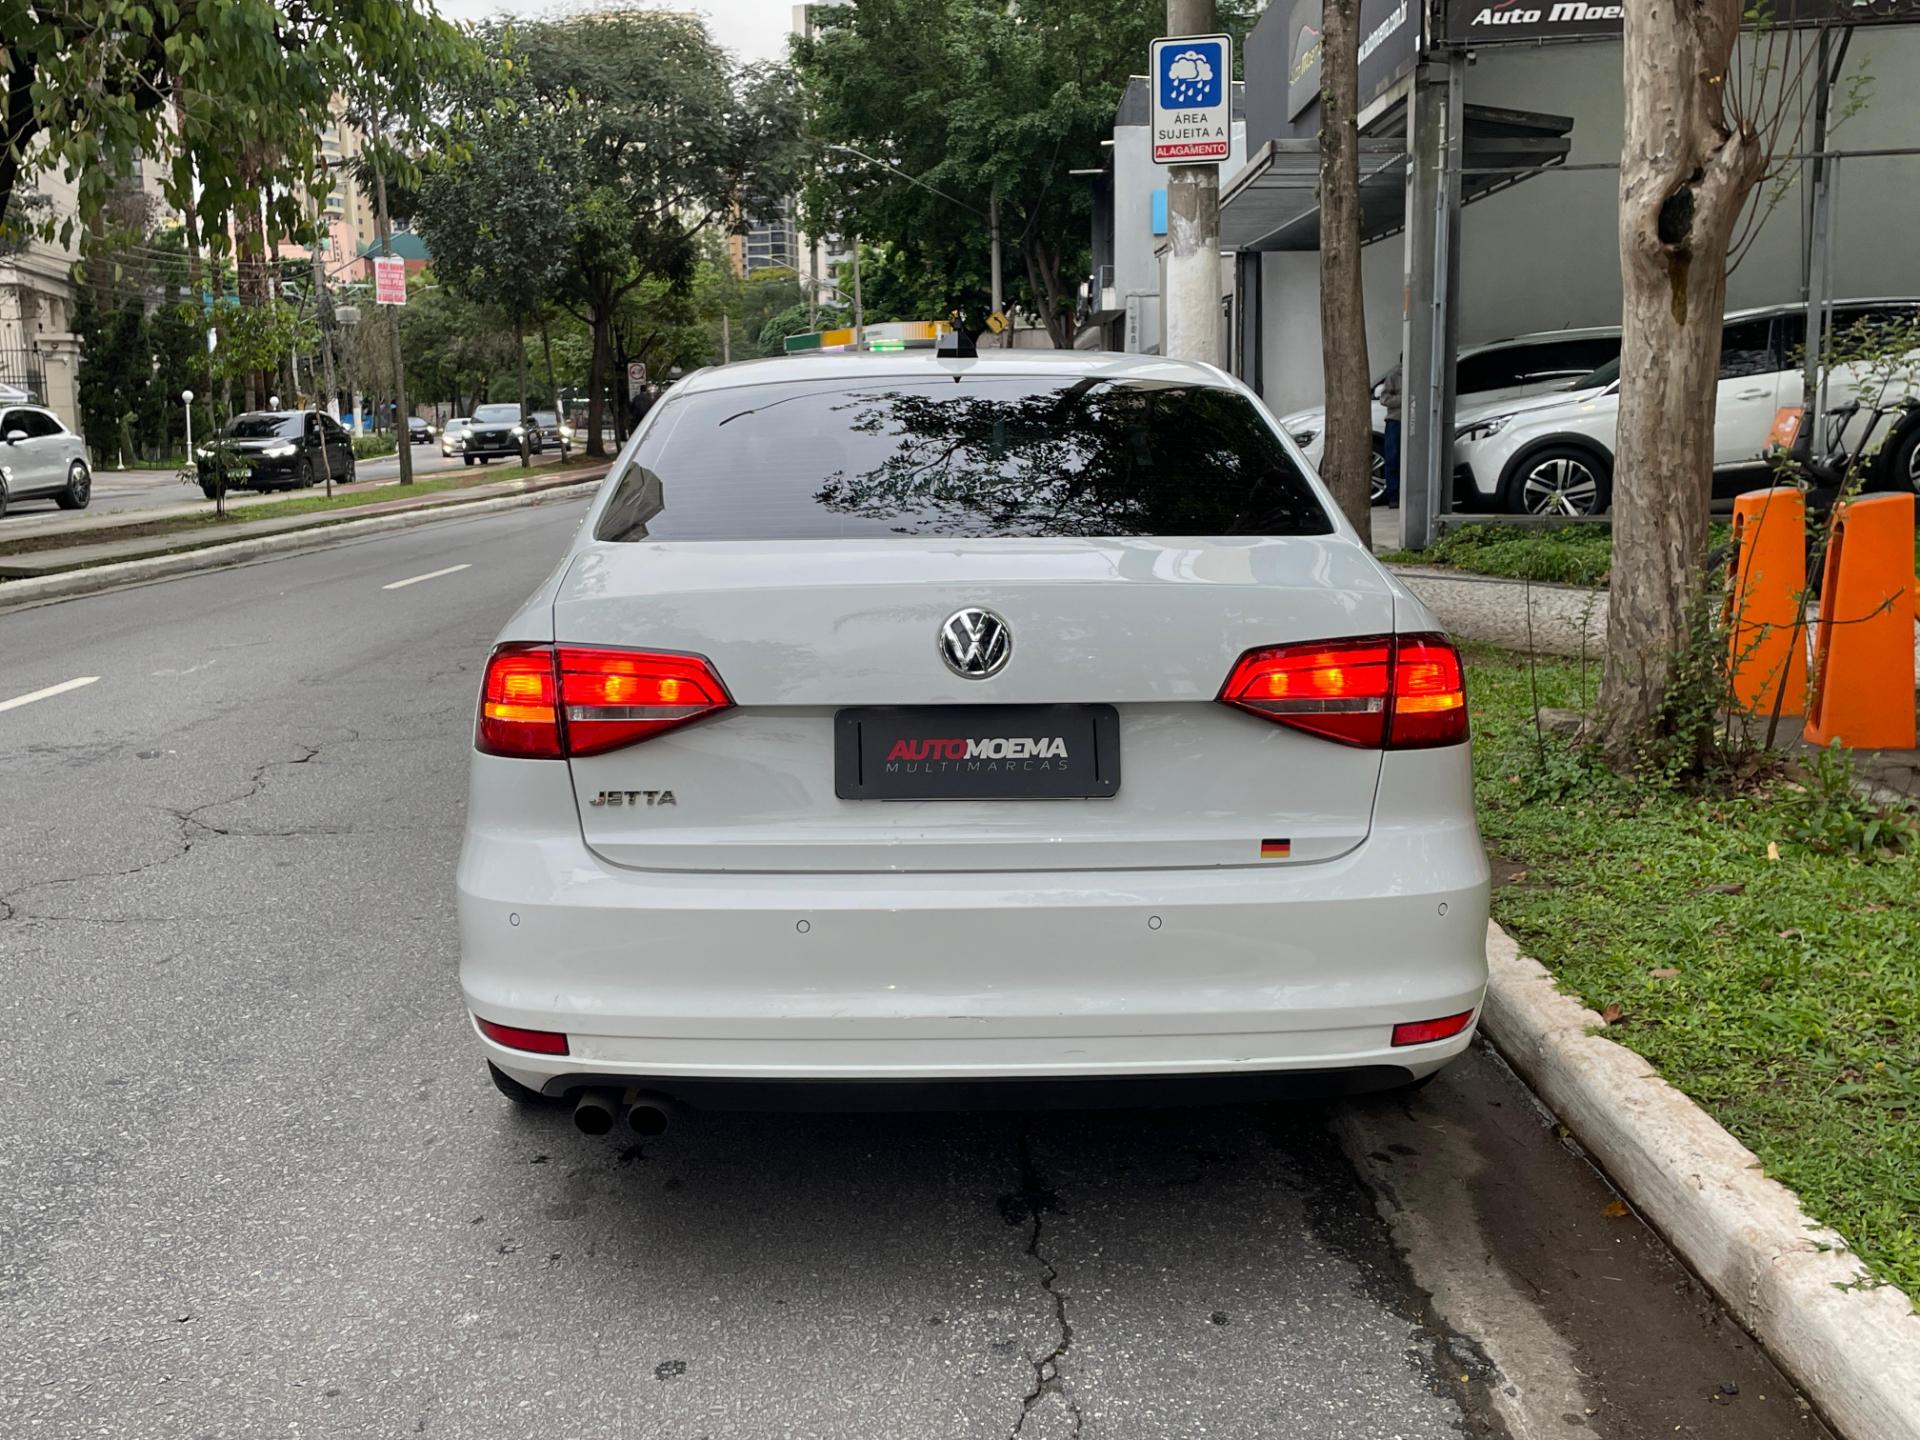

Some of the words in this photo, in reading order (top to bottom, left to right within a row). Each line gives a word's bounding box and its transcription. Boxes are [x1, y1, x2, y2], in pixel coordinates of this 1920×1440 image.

[1470, 9, 1541, 26] Auto
[1548, 2, 1625, 22] Moe
[1174, 112, 1208, 124] ÁREA
[1159, 128, 1210, 140] SUJEITA
[1215, 126, 1224, 137] A
[1156, 144, 1226, 156] ALAGAMENTO
[886, 737, 1069, 761] AUTOMOEMA
[886, 760, 1069, 773] MULTIMARCAS
[589, 790, 677, 807] JETTA
